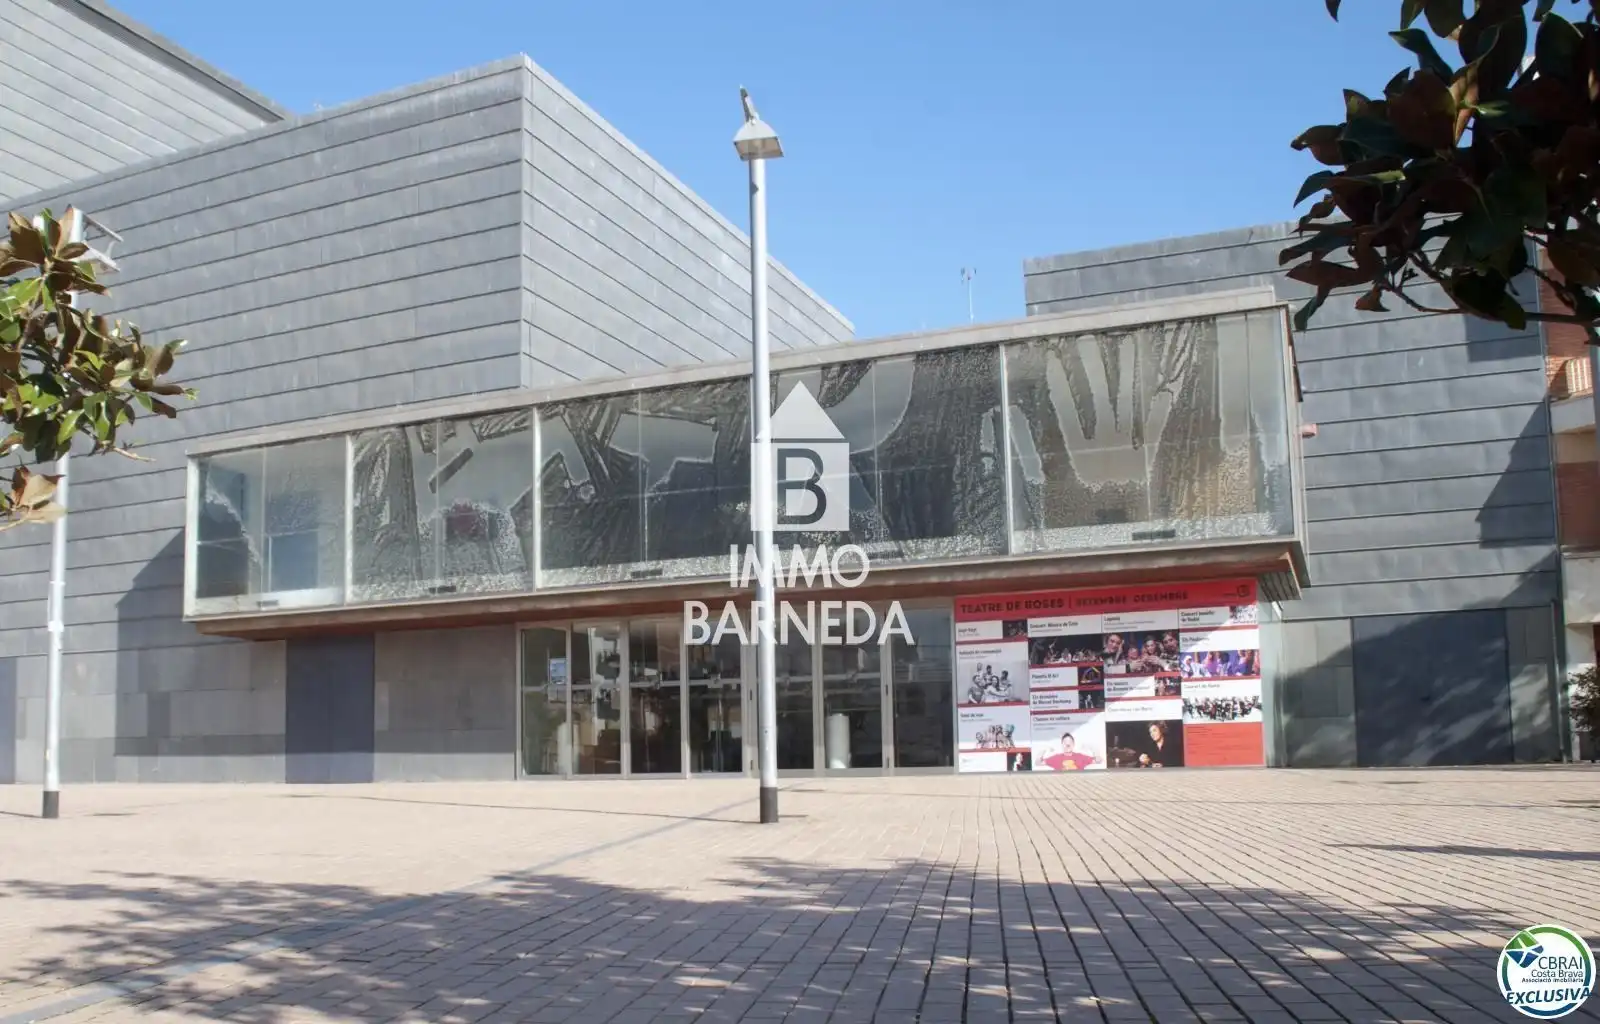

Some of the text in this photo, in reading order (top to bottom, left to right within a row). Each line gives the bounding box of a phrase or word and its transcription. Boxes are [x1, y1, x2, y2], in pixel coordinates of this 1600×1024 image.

[960, 602, 1004, 614] TEATRE
[1006, 601, 1021, 611] DE
[1024, 598, 1064, 610] ROSES
